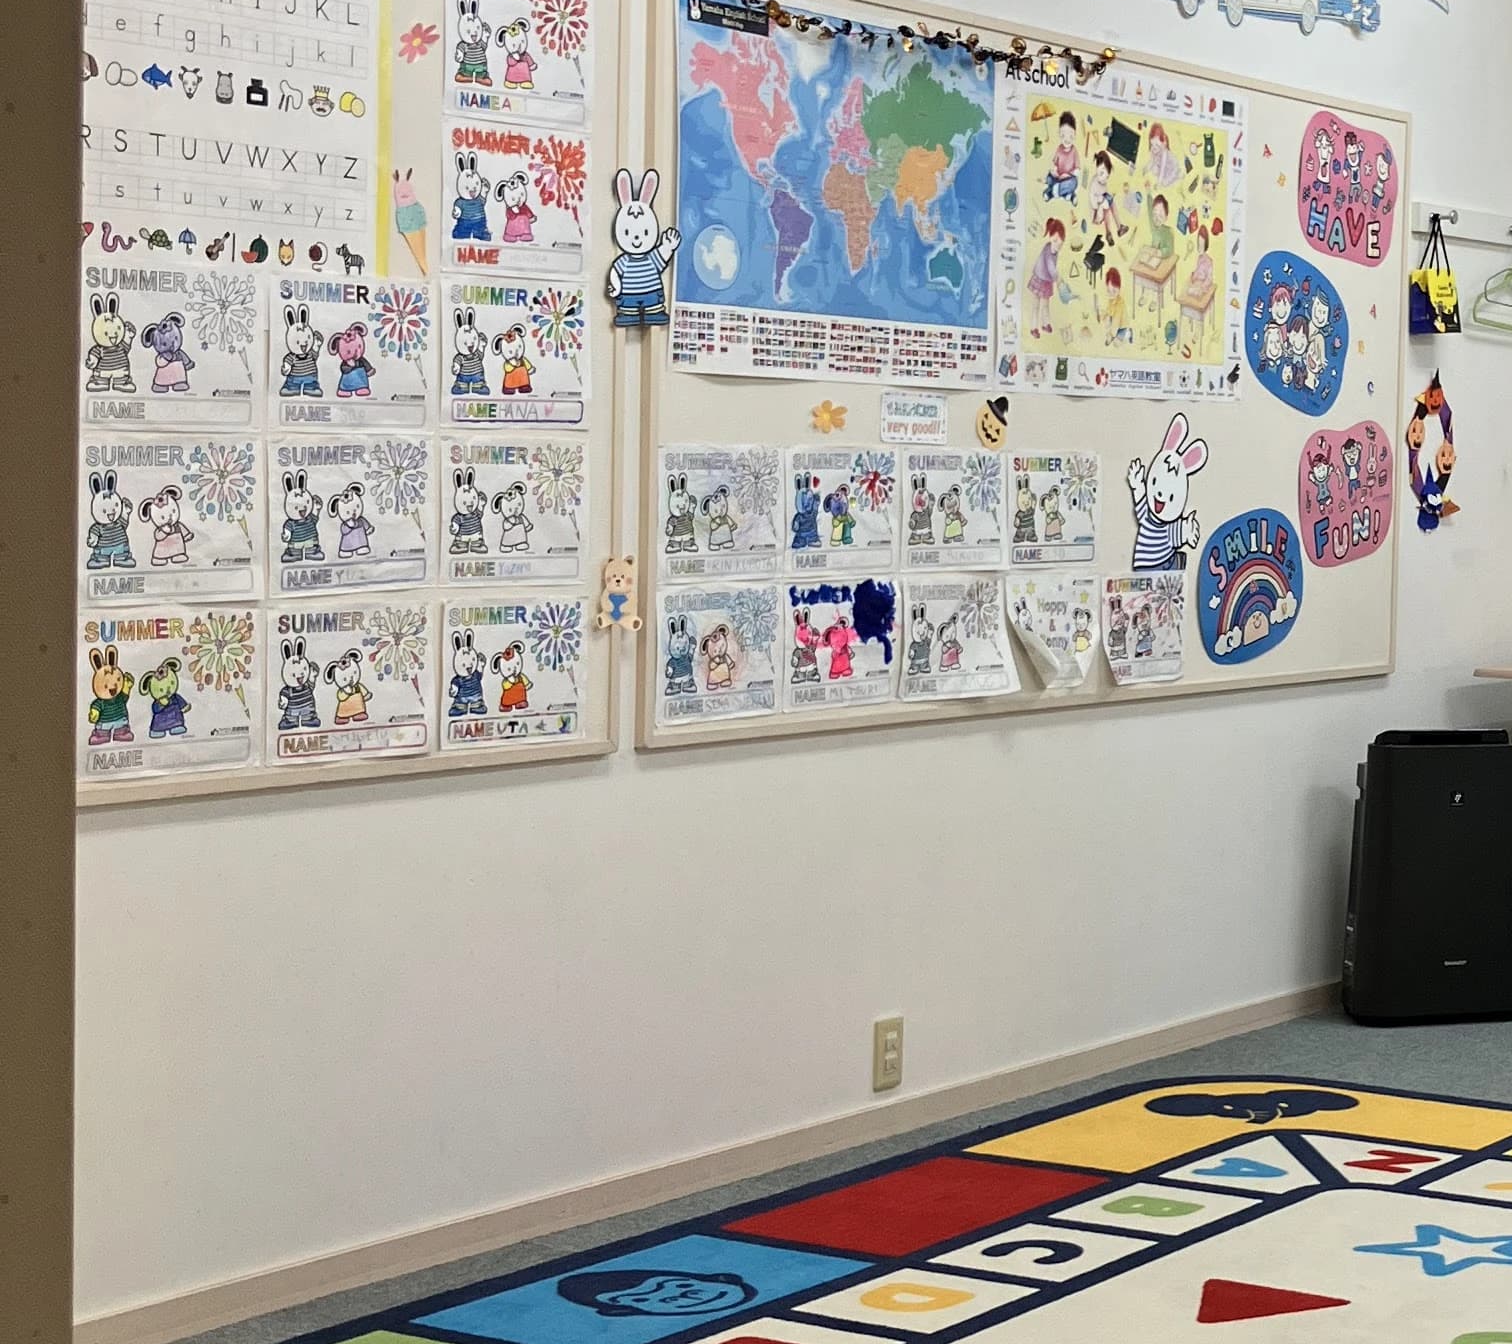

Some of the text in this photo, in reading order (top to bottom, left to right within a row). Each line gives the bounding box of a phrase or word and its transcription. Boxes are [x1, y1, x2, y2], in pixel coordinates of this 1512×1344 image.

[347, 2, 360, 26] L
[116, 17, 127, 31] e
[153, 13, 164, 37] f
[185, 29, 196, 53] g
[220, 24, 231, 49] h
[317, 39, 326, 63] k
[1024, 64, 1070, 90] school
[460, 90, 500, 112] NAME
[451, 127, 530, 156] SUMMER
[114, 128, 128, 153] S
[149, 132, 167, 157] T
[182, 137, 197, 161] U
[215, 140, 233, 165] V
[246, 144, 270, 169] W
[281, 148, 298, 173] X
[316, 152, 328, 175] Y
[343, 156, 359, 180] Z
[115, 182, 354, 228] s t u v w x y z
[1307, 197, 1381, 259] HAVE
[456, 245, 500, 266] NAME
[86, 267, 187, 293] SUMMER
[279, 279, 370, 304] SUMMER
[450, 284, 528, 308] SUMMER
[92, 401, 146, 420] NAME
[284, 405, 331, 423] NAME
[456, 402, 497, 419] NAME
[86, 445, 184, 467] SUMMER
[278, 444, 366, 467] SUMMER
[450, 444, 528, 465] SUMMER
[664, 453, 732, 471] SUMMER
[792, 453, 850, 471] SUMMER
[908, 454, 961, 471] SUMMER
[1013, 457, 1062, 473] SUMMER
[1314, 506, 1382, 560] FUN!
[796, 554, 827, 568] NAME
[1015, 548, 1042, 561] NAME
[453, 561, 496, 578] NAME
[669, 558, 705, 574] NAME
[92, 576, 145, 595] NAME
[285, 568, 332, 587] NAME
[1106, 578, 1153, 594] SUMMER
[909, 582, 964, 601] SUMMER
[664, 592, 731, 613] SUMMER
[278, 611, 366, 634] SUMMER
[448, 606, 527, 625] SUMMER
[84, 618, 184, 644] SUMMER
[795, 688, 827, 704] NAME
[453, 721, 494, 739] NAME
[283, 734, 329, 754] NAME
[92, 750, 144, 771] NAME
[1191, 1157, 1288, 1178] A
[1101, 1194, 1206, 1217] B
[981, 1239, 1084, 1265] C
[858, 1282, 977, 1313] D
